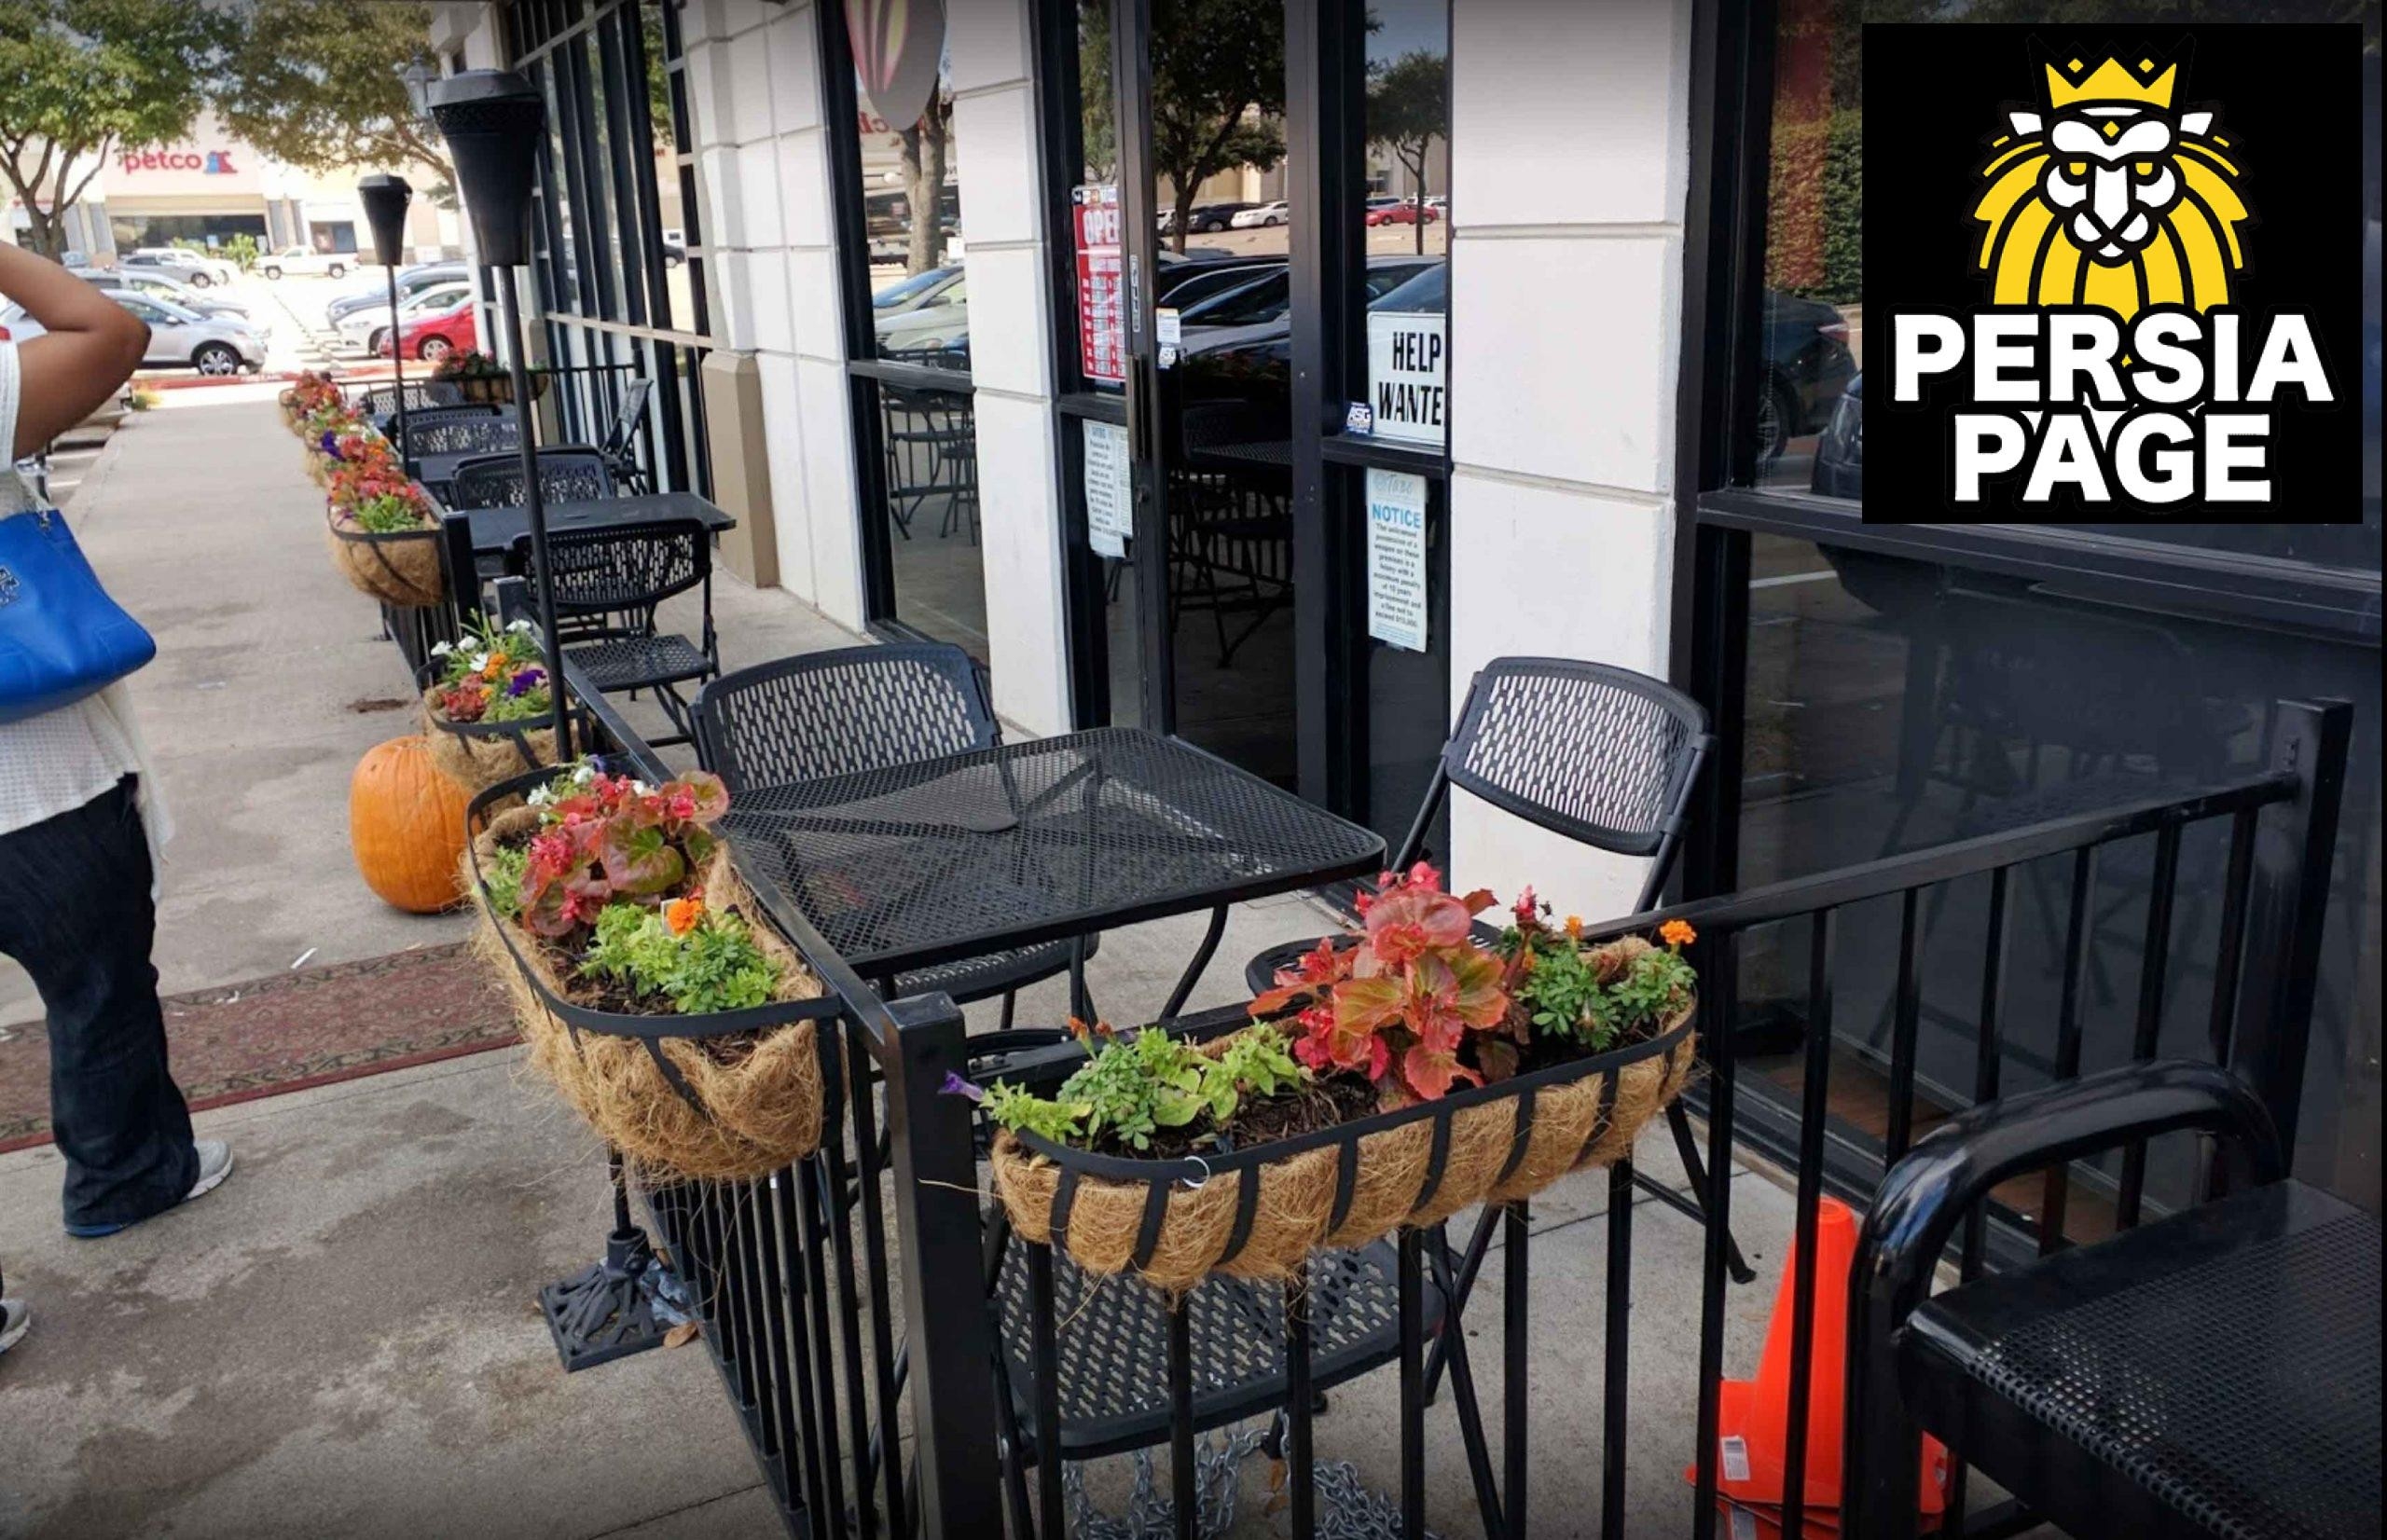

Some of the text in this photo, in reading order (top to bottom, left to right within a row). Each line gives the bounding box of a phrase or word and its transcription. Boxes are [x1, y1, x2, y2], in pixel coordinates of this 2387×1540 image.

[125, 151, 202, 175] petco
[1392, 331, 1441, 373] HELP
[1378, 381, 1443, 426] WANTE
[1372, 503, 1421, 529] NOTICE
